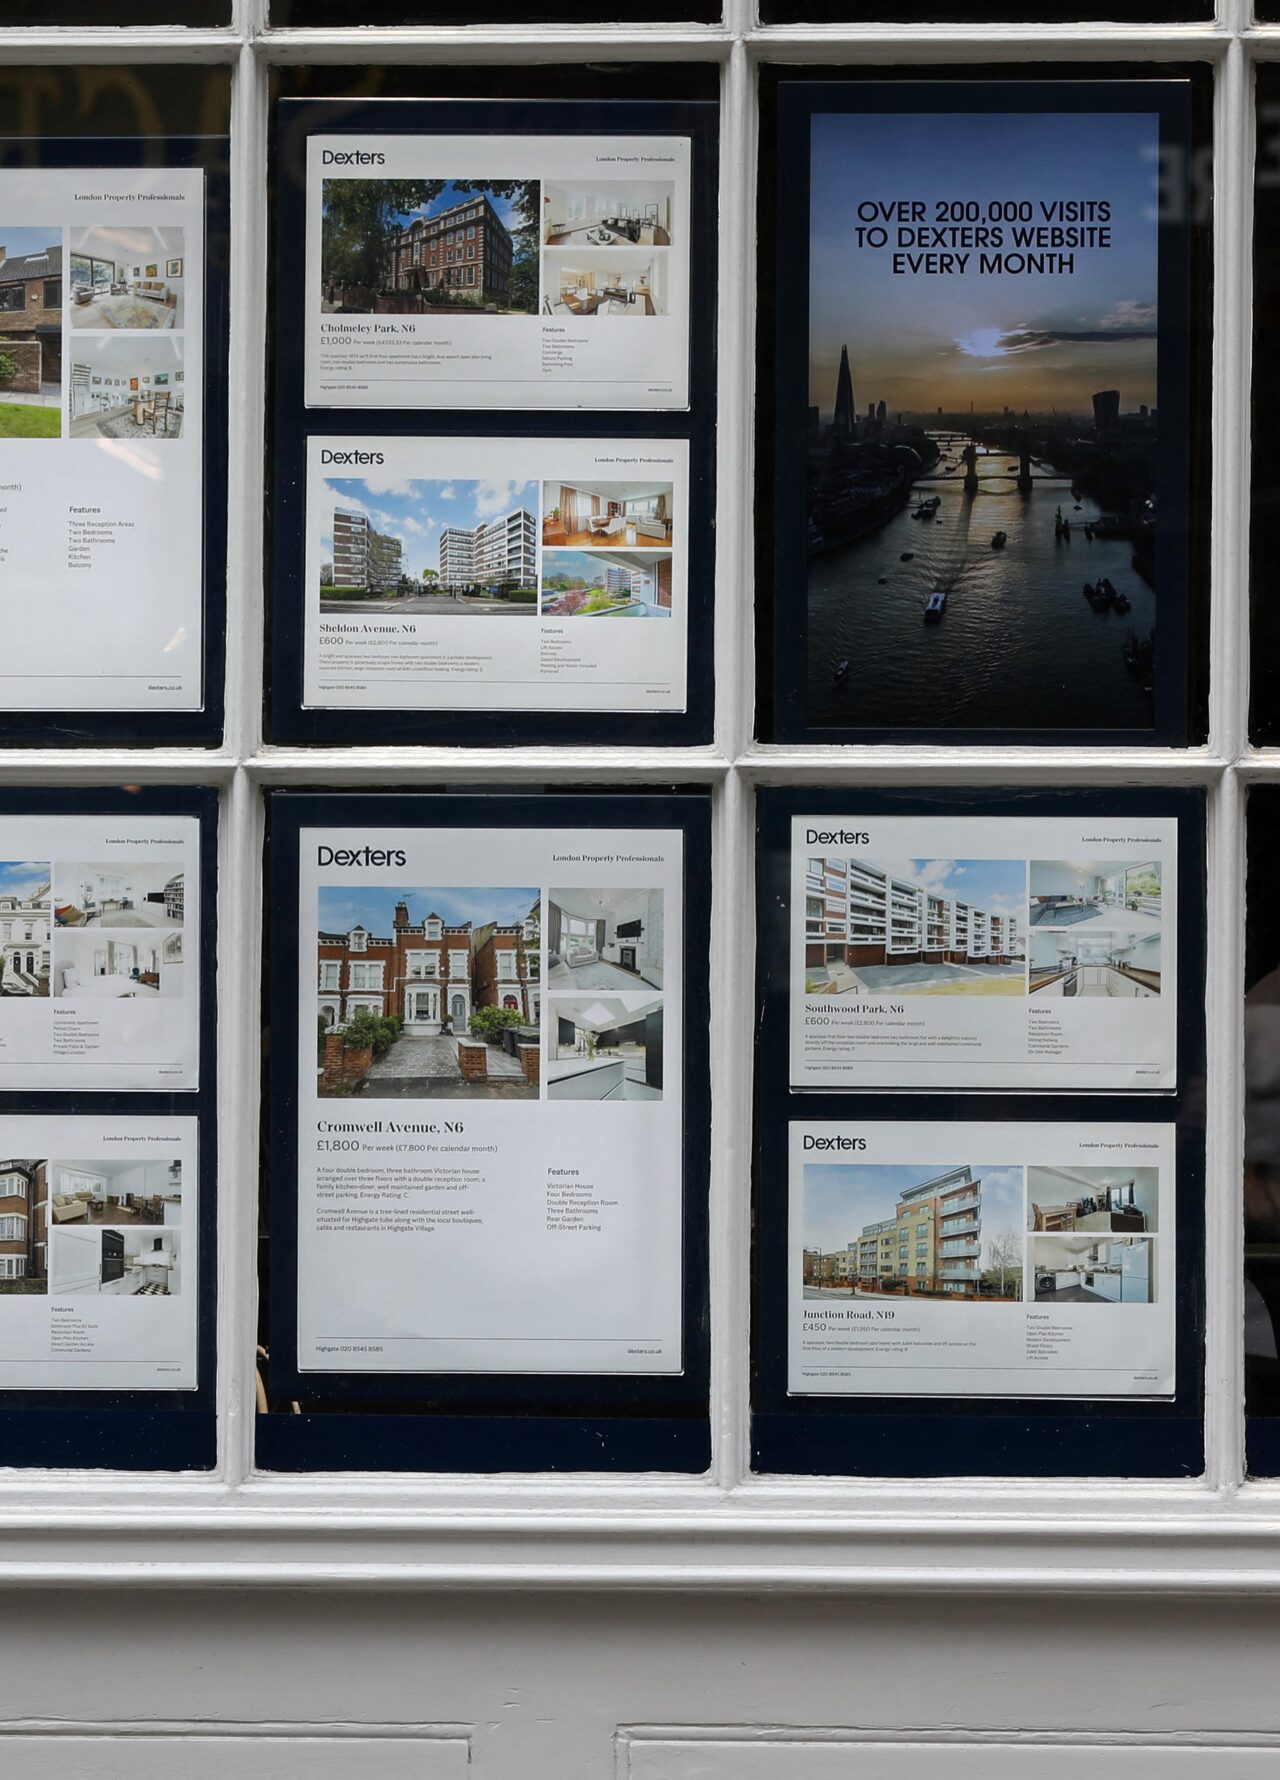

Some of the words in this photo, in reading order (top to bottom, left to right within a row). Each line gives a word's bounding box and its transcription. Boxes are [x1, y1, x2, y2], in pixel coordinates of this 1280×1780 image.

[322, 150, 385, 165] Dexters
[104, 193, 136, 202] Property
[857, 200, 927, 223] OVER
[935, 200, 1034, 225] 200,000
[1039, 200, 1111, 222] VISITS
[854, 226, 888, 248] TO
[898, 226, 1004, 248] DEXTERS
[1011, 226, 1111, 248] WEBSITE
[893, 253, 970, 274] EVERY
[980, 252, 1074, 274] MONTH
[320, 324, 372, 334] Cholmeley
[374, 324, 399, 333] Park,
[320, 336, 352, 346] £1,000
[321, 449, 384, 465] Dexters
[69, 506, 101, 514] Features
[86, 520, 117, 529] Reception
[360, 624, 400, 634] Avenue,
[402, 624, 416, 633] N6
[319, 636, 344, 645] £600
[806, 829, 870, 844] Dexters
[318, 846, 406, 867] Dexters
[582, 854, 614, 863] Property
[805, 1004, 860, 1014] Southwood
[862, 1005, 887, 1014] Park,
[890, 1005, 904, 1014] N6
[805, 1016, 830, 1026] £600
[317, 1121, 382, 1132] Cromwell
[386, 1121, 440, 1134] Avenue,
[444, 1122, 464, 1133] N6
[317, 1140, 360, 1152] £1,800
[803, 1135, 867, 1150] Dexters
[548, 1168, 580, 1176] Features
[802, 1310, 844, 1319] Junction
[846, 1310, 874, 1320] Road,
[802, 1322, 827, 1332] £450
